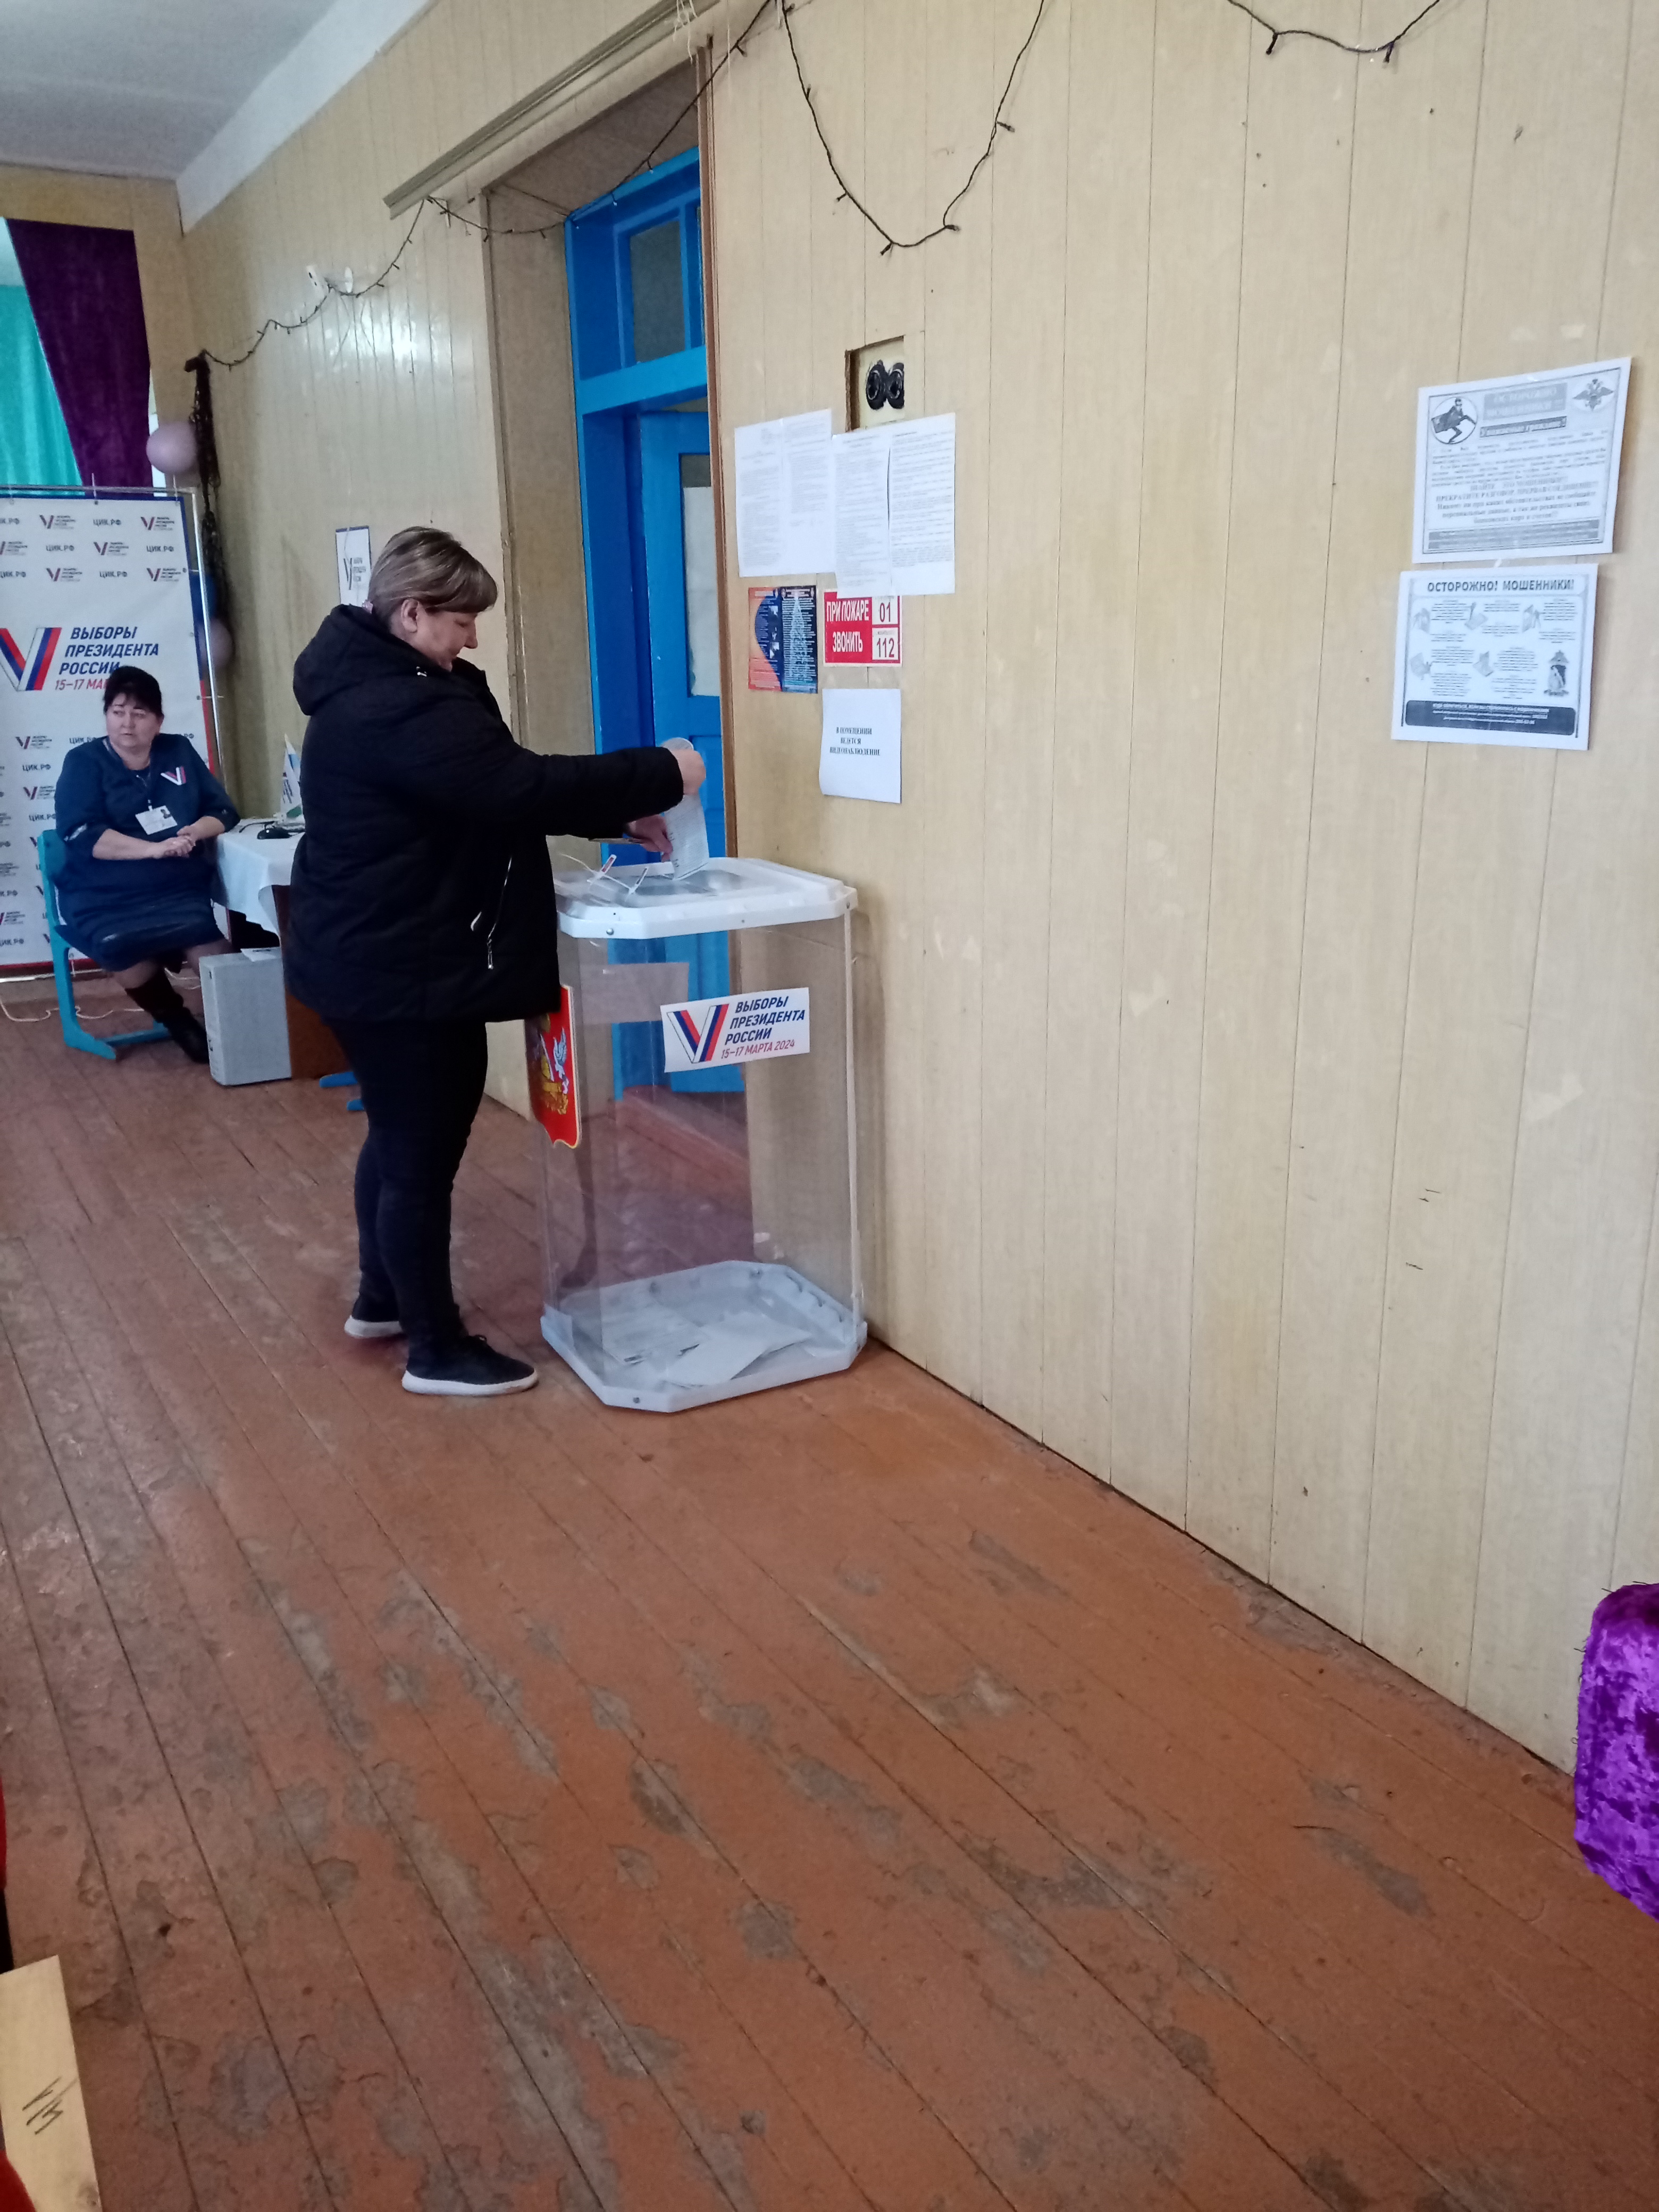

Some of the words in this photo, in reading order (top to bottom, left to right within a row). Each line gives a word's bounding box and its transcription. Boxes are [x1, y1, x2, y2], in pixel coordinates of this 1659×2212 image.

[1427, 580, 1497, 592] ОСТОРОЖНО!
[1502, 579, 1574, 591] МОШЕННИКИ!
[826, 601, 841, 622] ПРИ
[841, 599, 869, 622] ПОЖАРЕ
[879, 602, 891, 622] 01
[70, 626, 138, 640] ВЫБОРЫ
[832, 631, 863, 652] ЗВОНИТЬ
[64, 643, 159, 658] ПРЕЗИДЕНТА
[877, 638, 894, 658] 112
[830, 747, 880, 756] ВИДЕОНАБЛЮДЕНИЕ
[22, 764, 51, 772] ЦИК.РФ
[735, 996, 789, 1013] ВЫБОРЫ
[730, 1010, 805, 1029] ПРЕЗИДЕНТА
[725, 1027, 772, 1045] РОССИИ
[744, 1042, 773, 1055] МАРТА
[774, 1039, 795, 1051] 2024
